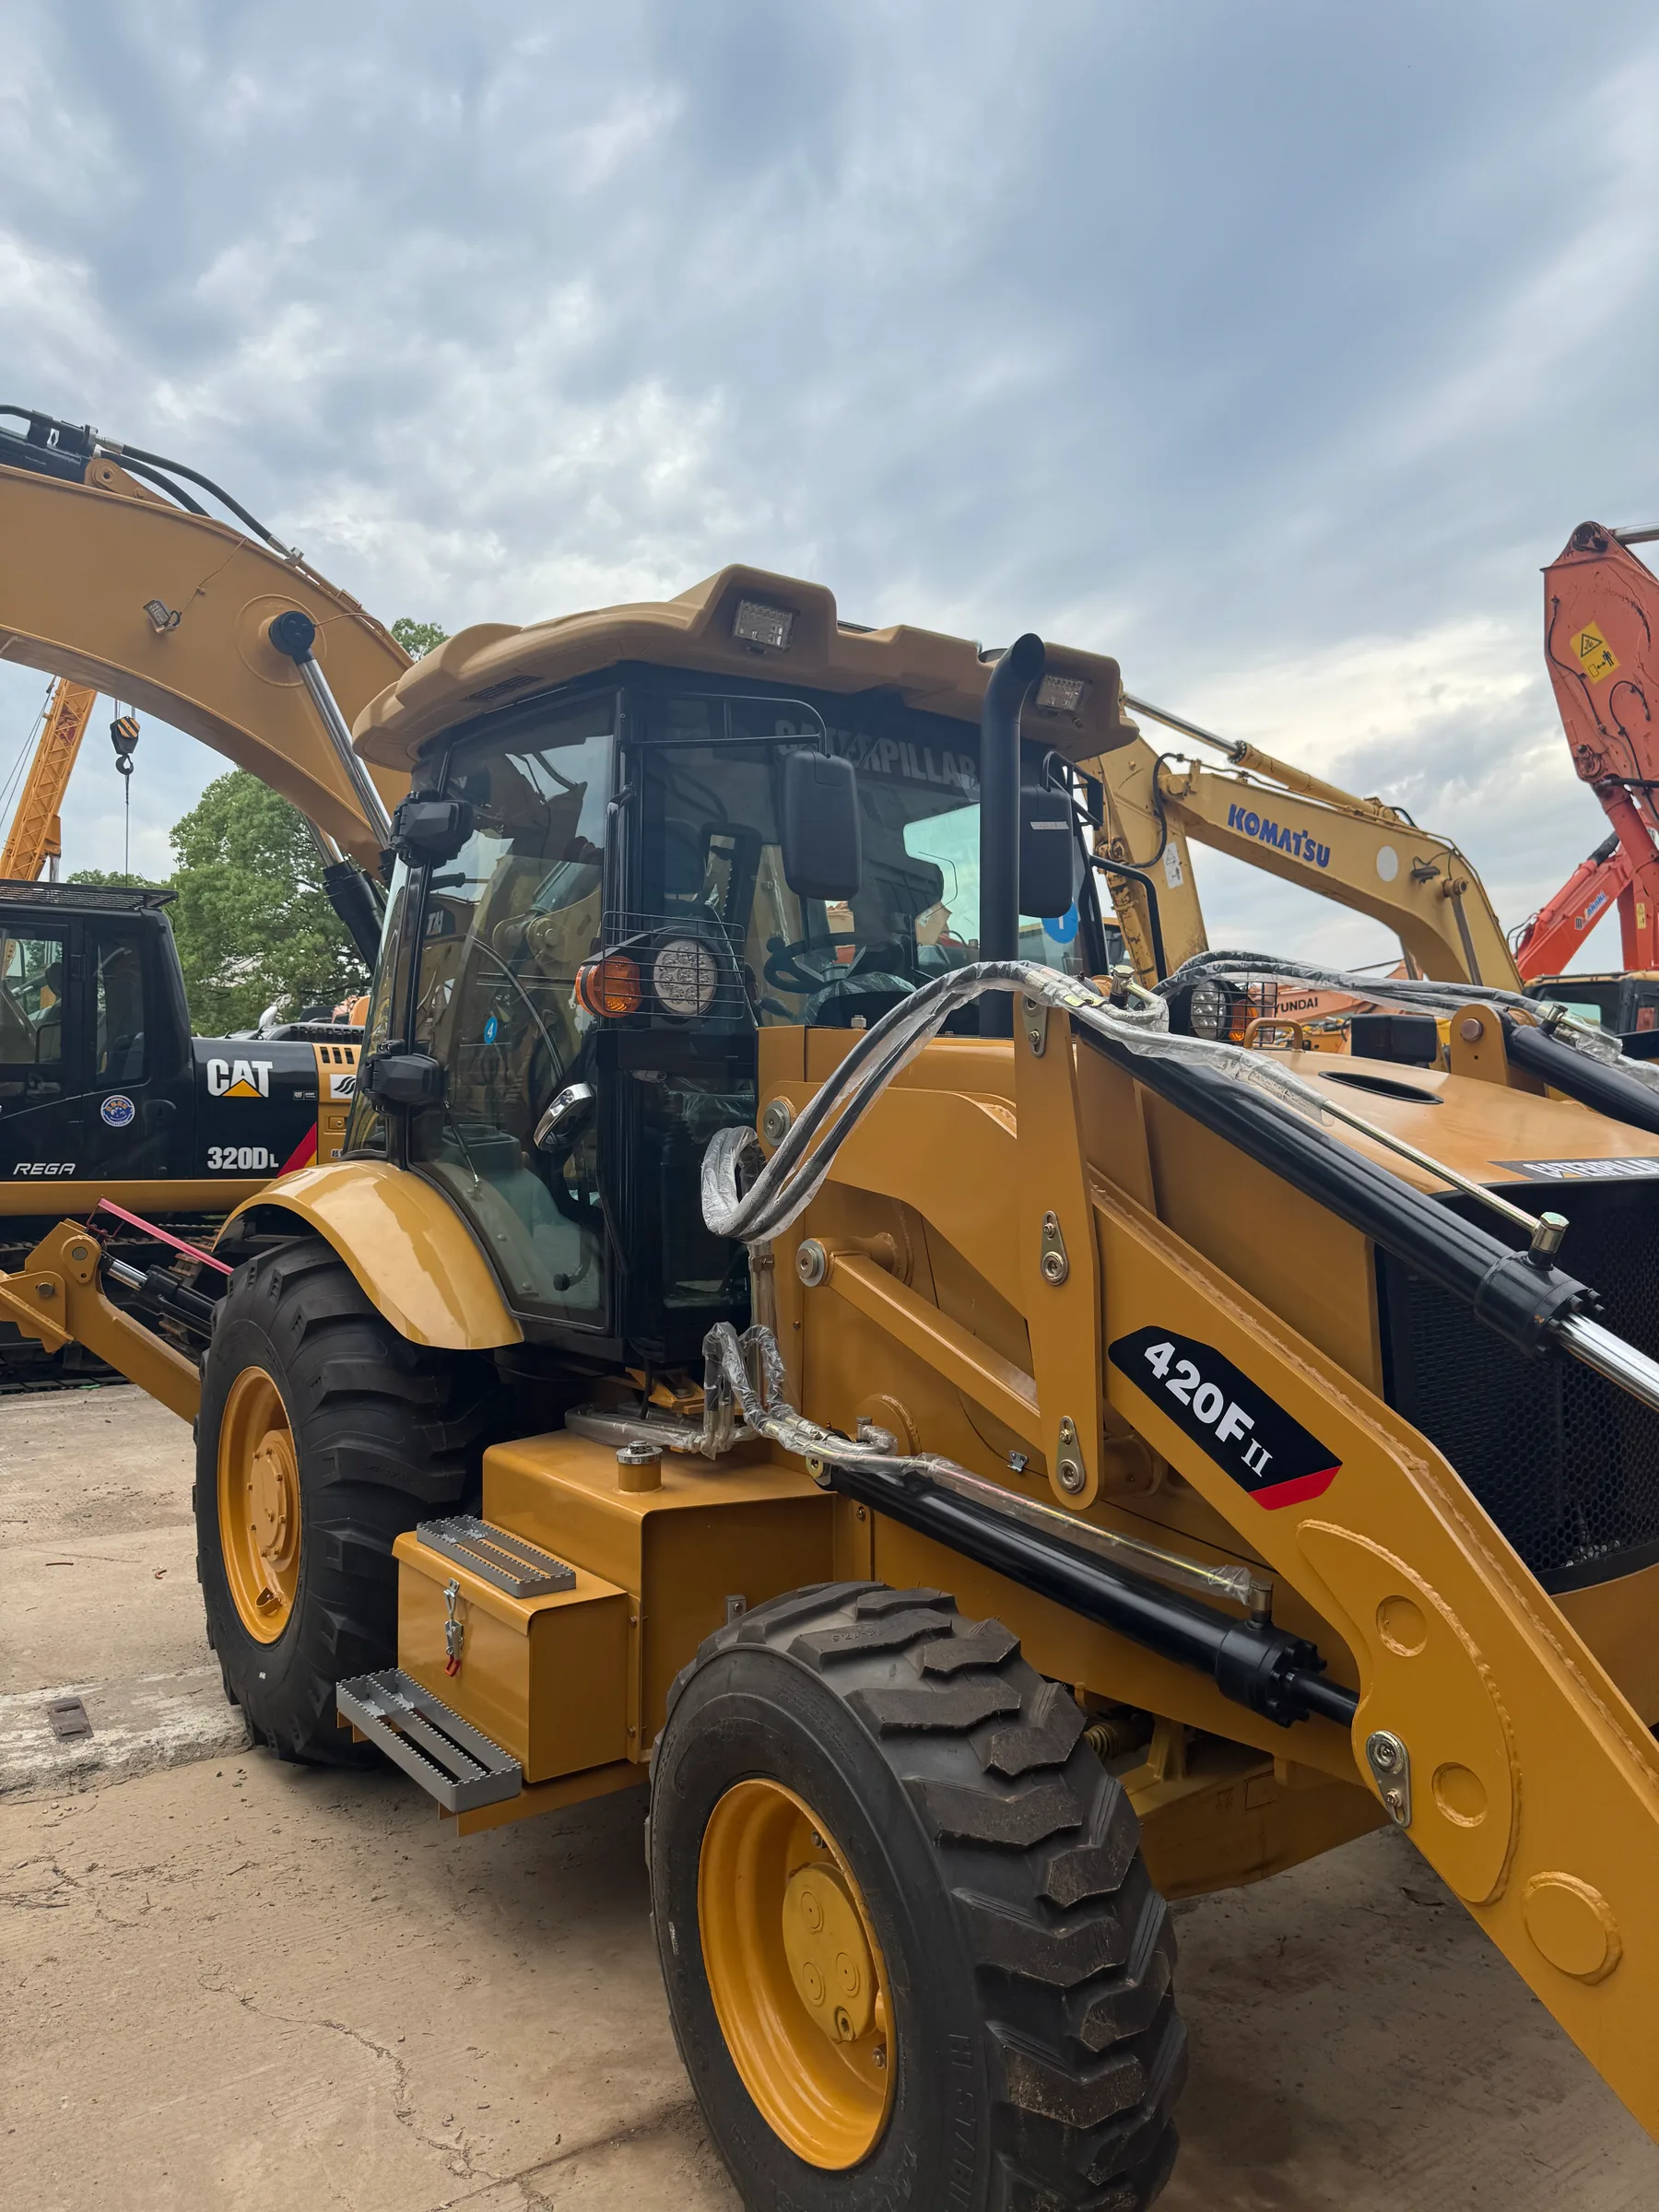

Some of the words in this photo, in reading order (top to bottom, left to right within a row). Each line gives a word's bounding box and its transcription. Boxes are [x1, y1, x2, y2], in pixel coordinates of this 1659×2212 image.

[1228, 804, 1331, 868] KOMATSU
[1276, 997, 1318, 1014] YUNDAI
[206, 1059, 273, 1098] CAT
[13, 1163, 76, 1175] REGA
[1144, 1342, 1255, 1442] 420F
